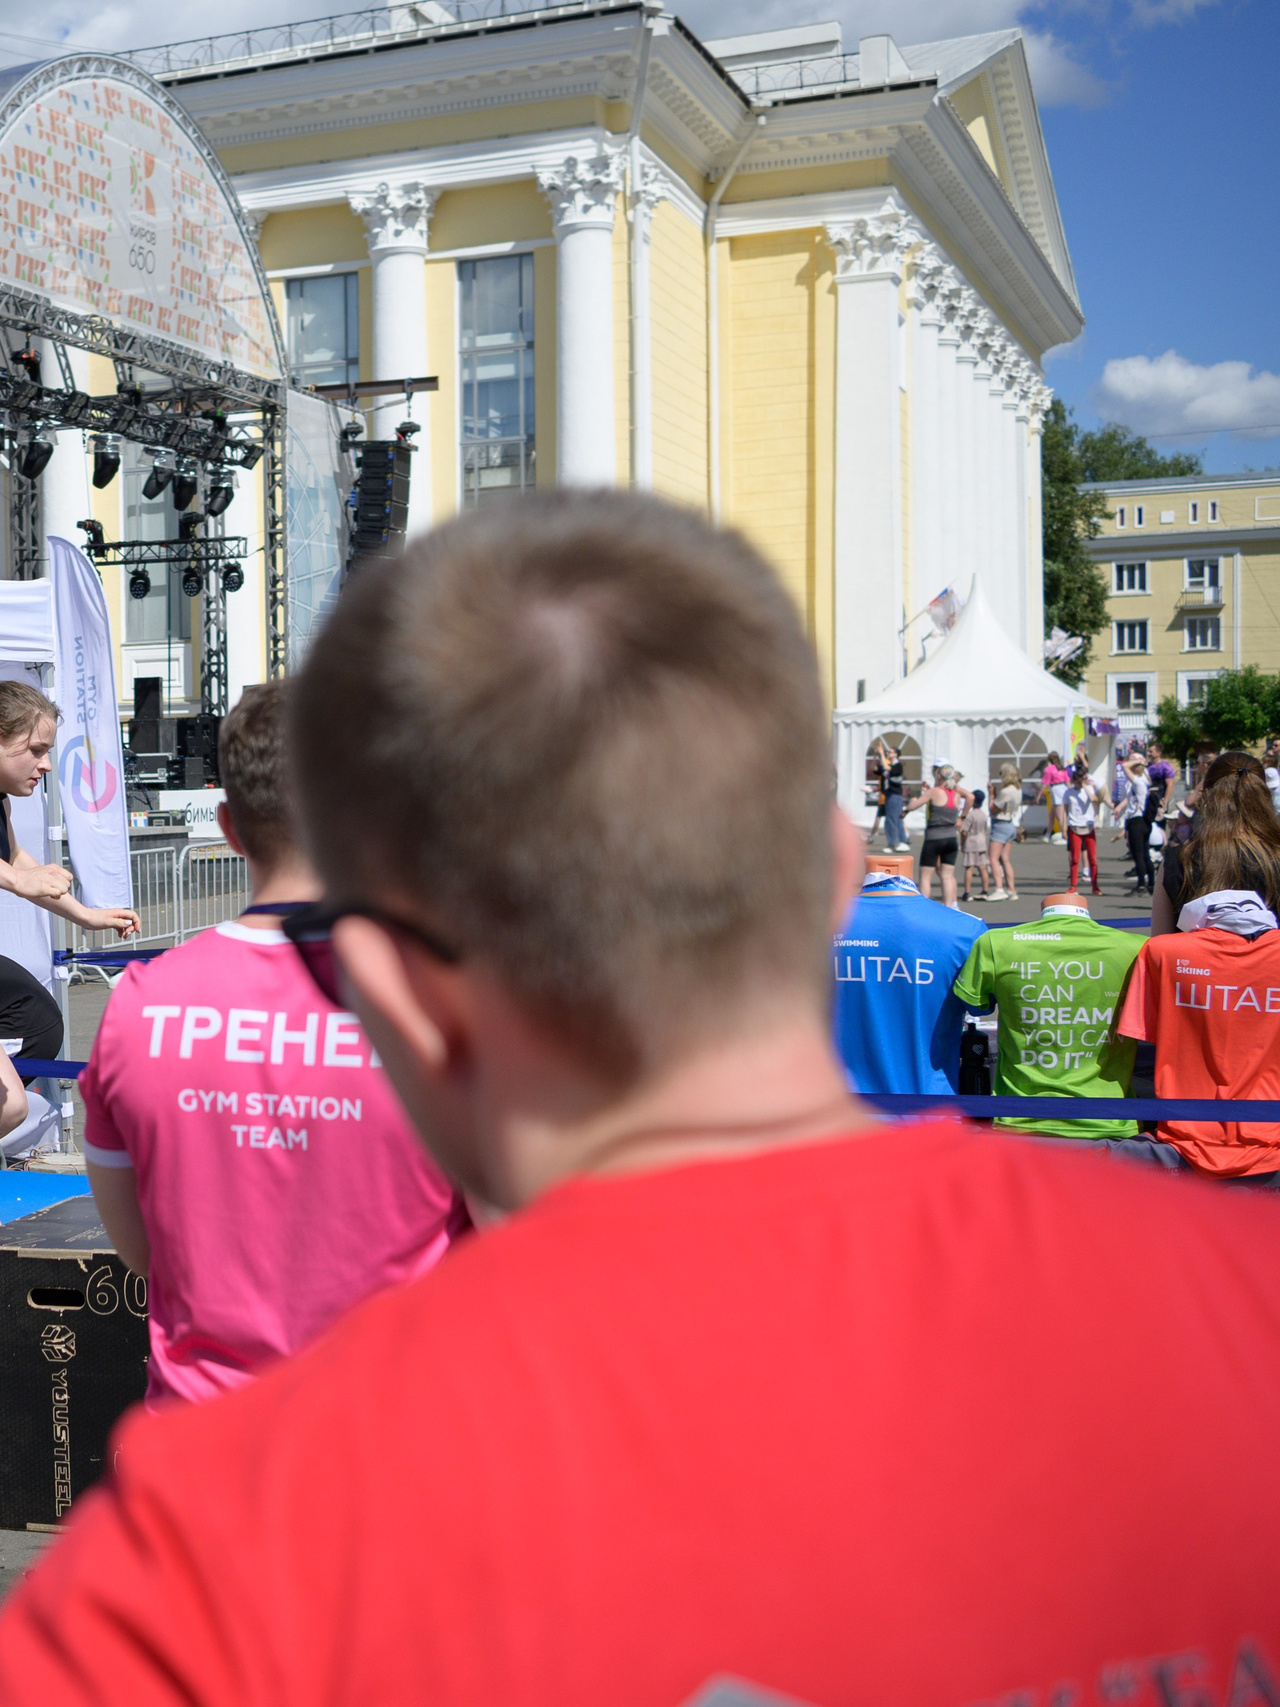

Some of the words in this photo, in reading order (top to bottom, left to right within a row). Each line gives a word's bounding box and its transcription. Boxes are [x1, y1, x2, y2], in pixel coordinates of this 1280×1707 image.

[130, 223, 156, 246] КИРОВ
[129, 243, 155, 274] 650
[186, 802, 216, 823] бимы
[1013, 933, 1062, 941] RUNNING
[834, 956, 934, 985] ШТАБ
[1048, 961, 1104, 980] YOU
[1176, 967, 1210, 976] SKIING
[1020, 985, 1074, 1003] CAN
[1021, 1007, 1114, 1026] DREAM
[142, 1005, 382, 1068] ТРЕНЕ
[1022, 1030, 1073, 1047] YOU
[1081, 1029, 1125, 1047] CAN
[1021, 1050, 1058, 1069] DO
[178, 1089, 238, 1115] GYM
[245, 1093, 362, 1121] STATION
[231, 1124, 308, 1151] TEAM
[86, 1265, 150, 1316] 60
[51, 1368, 72, 1517] YOUSTEEL
